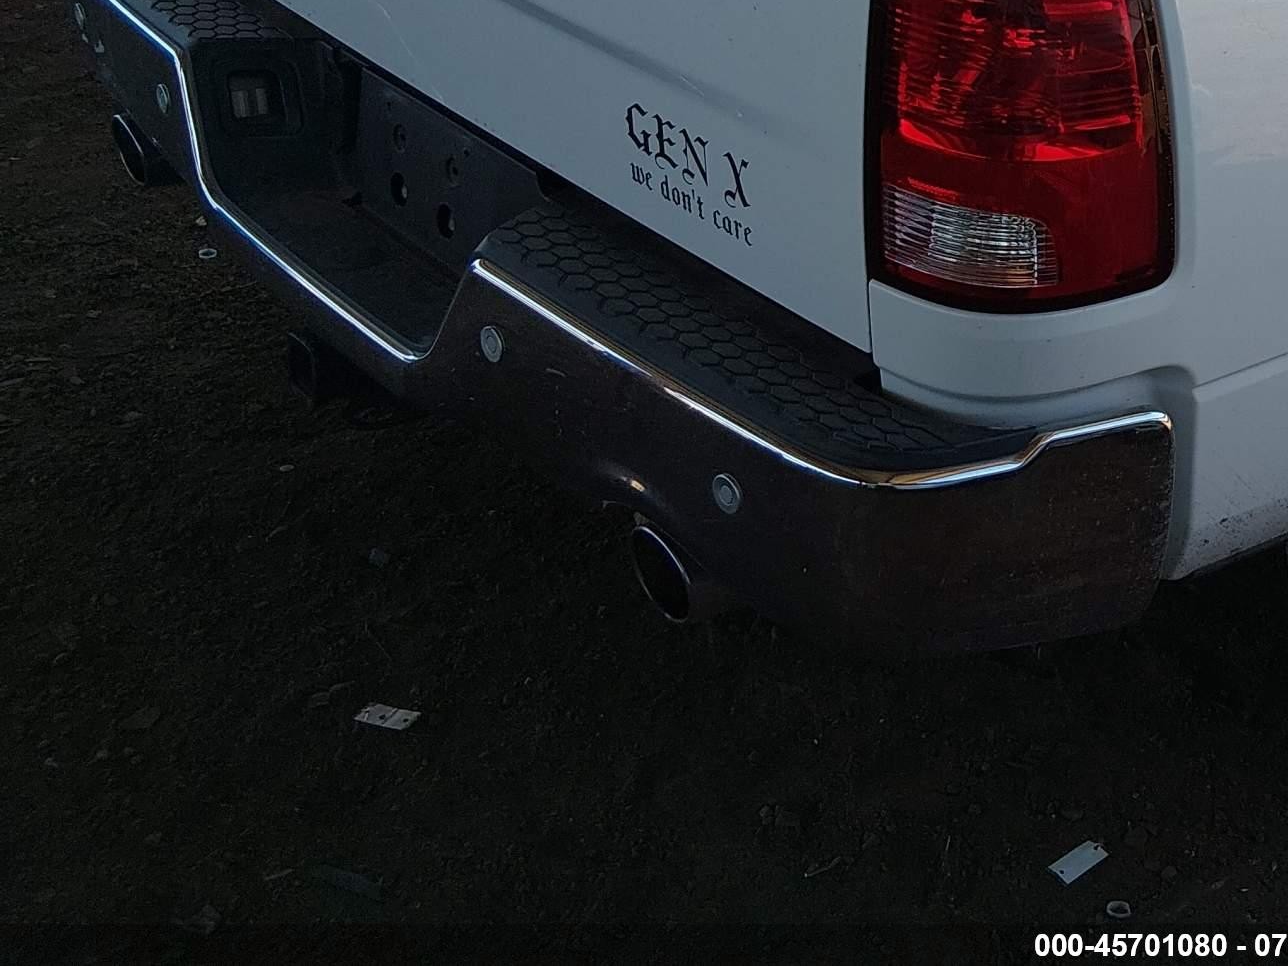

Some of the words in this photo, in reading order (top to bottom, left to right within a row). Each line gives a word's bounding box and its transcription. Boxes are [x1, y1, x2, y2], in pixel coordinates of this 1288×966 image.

[625, 103, 709, 186] GEN
[723, 152, 751, 208] X
[630, 162, 652, 191] we
[660, 175, 704, 220] don't
[713, 209, 752, 246] care
